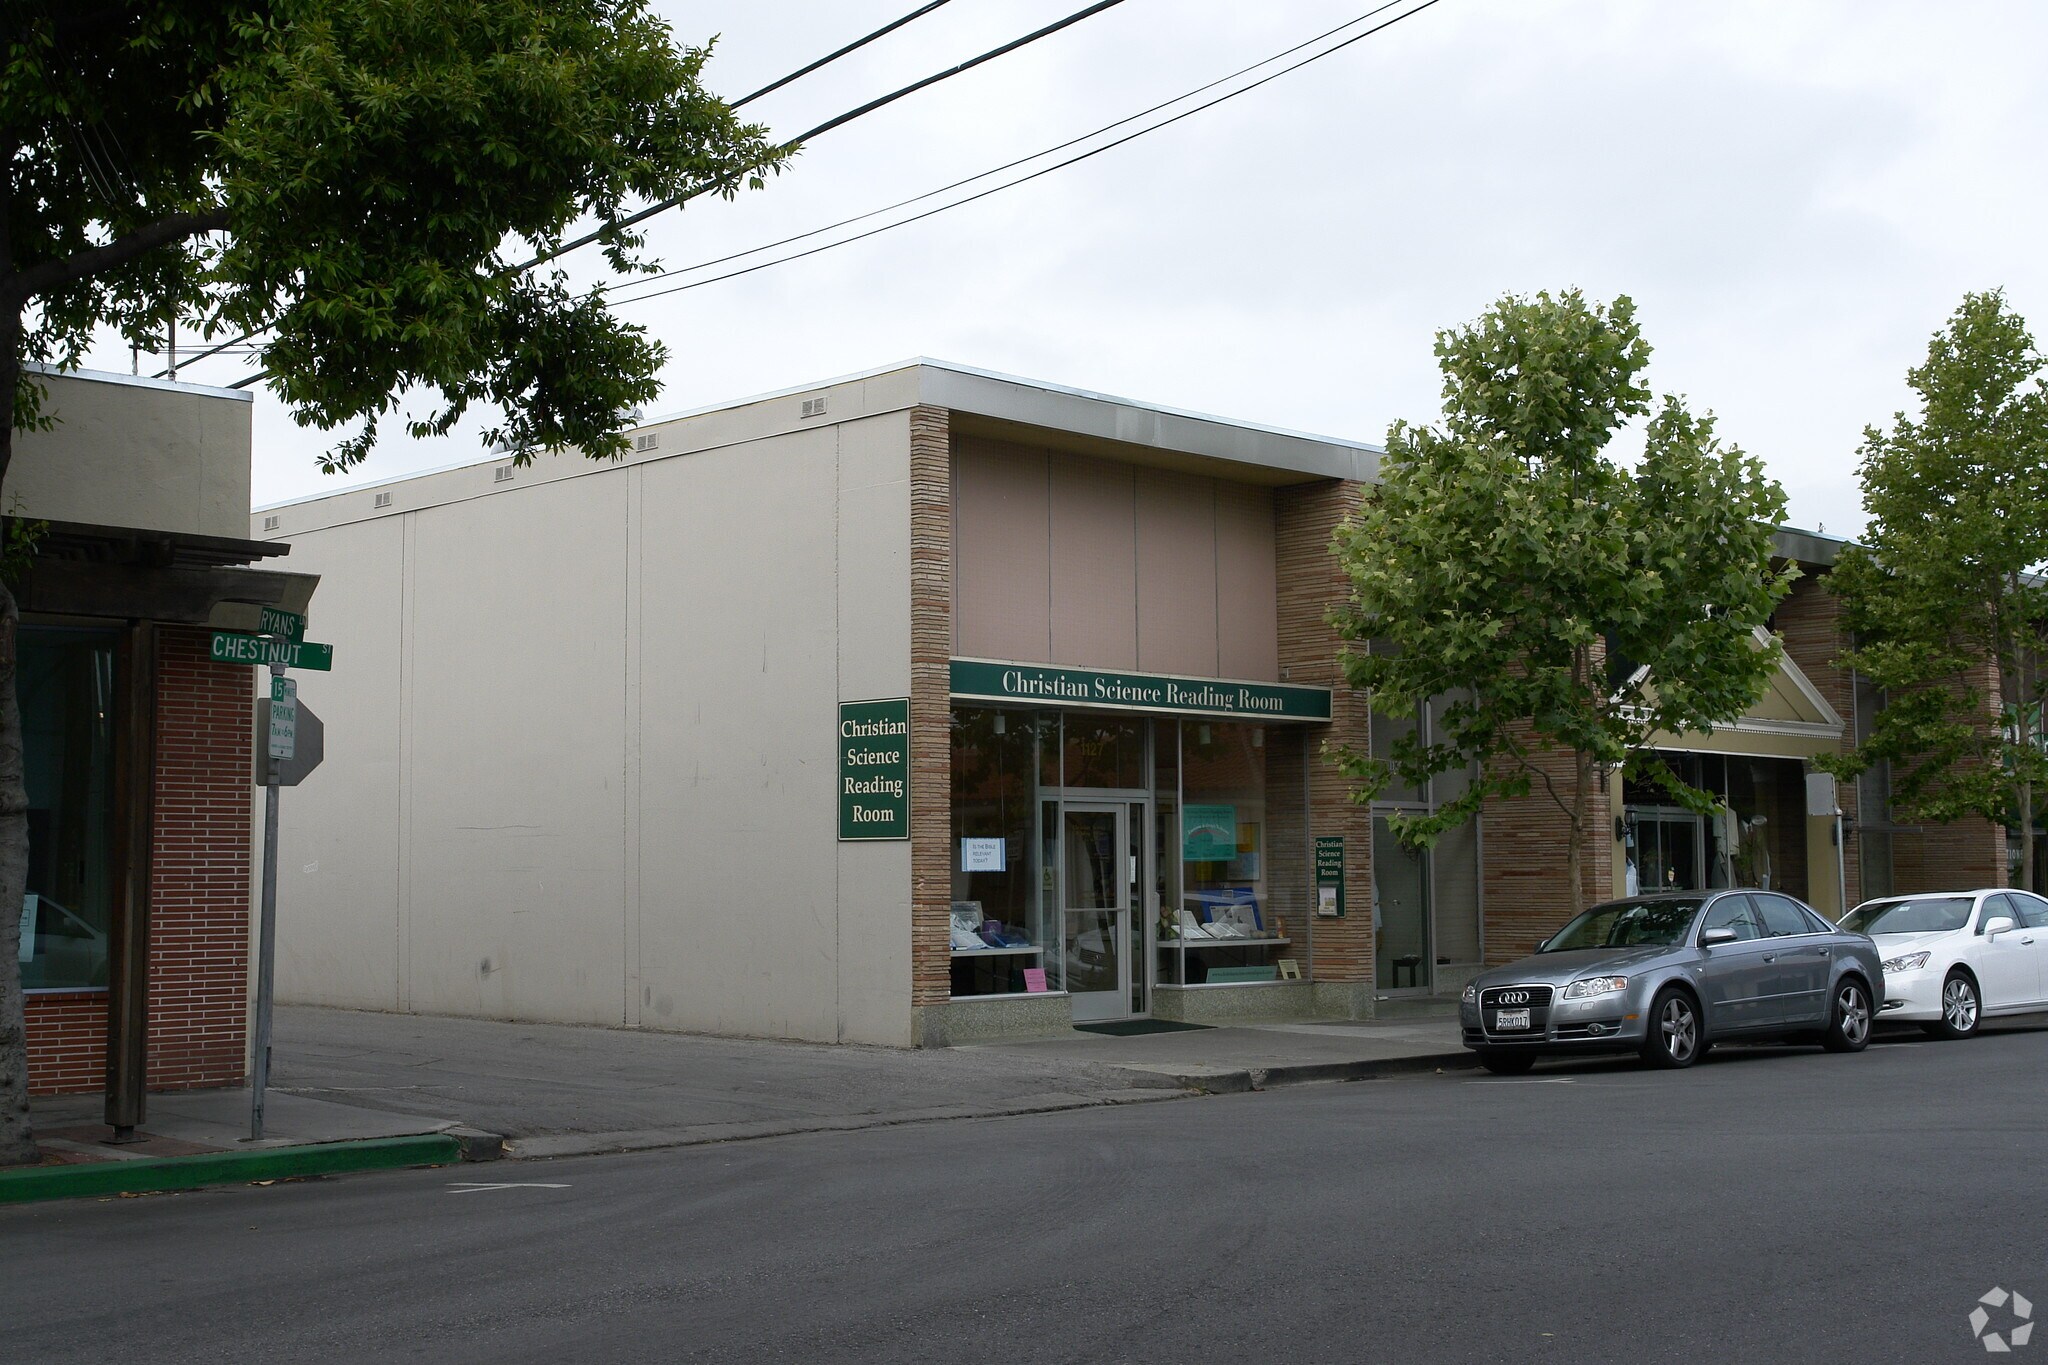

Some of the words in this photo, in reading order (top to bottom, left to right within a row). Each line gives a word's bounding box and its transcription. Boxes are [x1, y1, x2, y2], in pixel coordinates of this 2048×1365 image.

[260, 610, 295, 636] RYANS
[213, 636, 301, 664] CHESTNUT
[321, 644, 332, 654] ST
[274, 681, 283, 697] 15
[1002, 670, 1089, 698] Christian
[1094, 676, 1161, 703] Science
[1166, 682, 1234, 713] Reading
[1239, 688, 1283, 711] Room
[272, 704, 295, 722] PARKING
[841, 717, 906, 738] Christian
[847, 747, 900, 766] Science
[1081, 742, 1104, 757] 1127
[844, 775, 903, 798] Reading
[852, 805, 894, 822] Room
[1318, 850, 1340, 858] Science
[1317, 859, 1342, 868] Reading
[1321, 868, 1338, 876] Room
